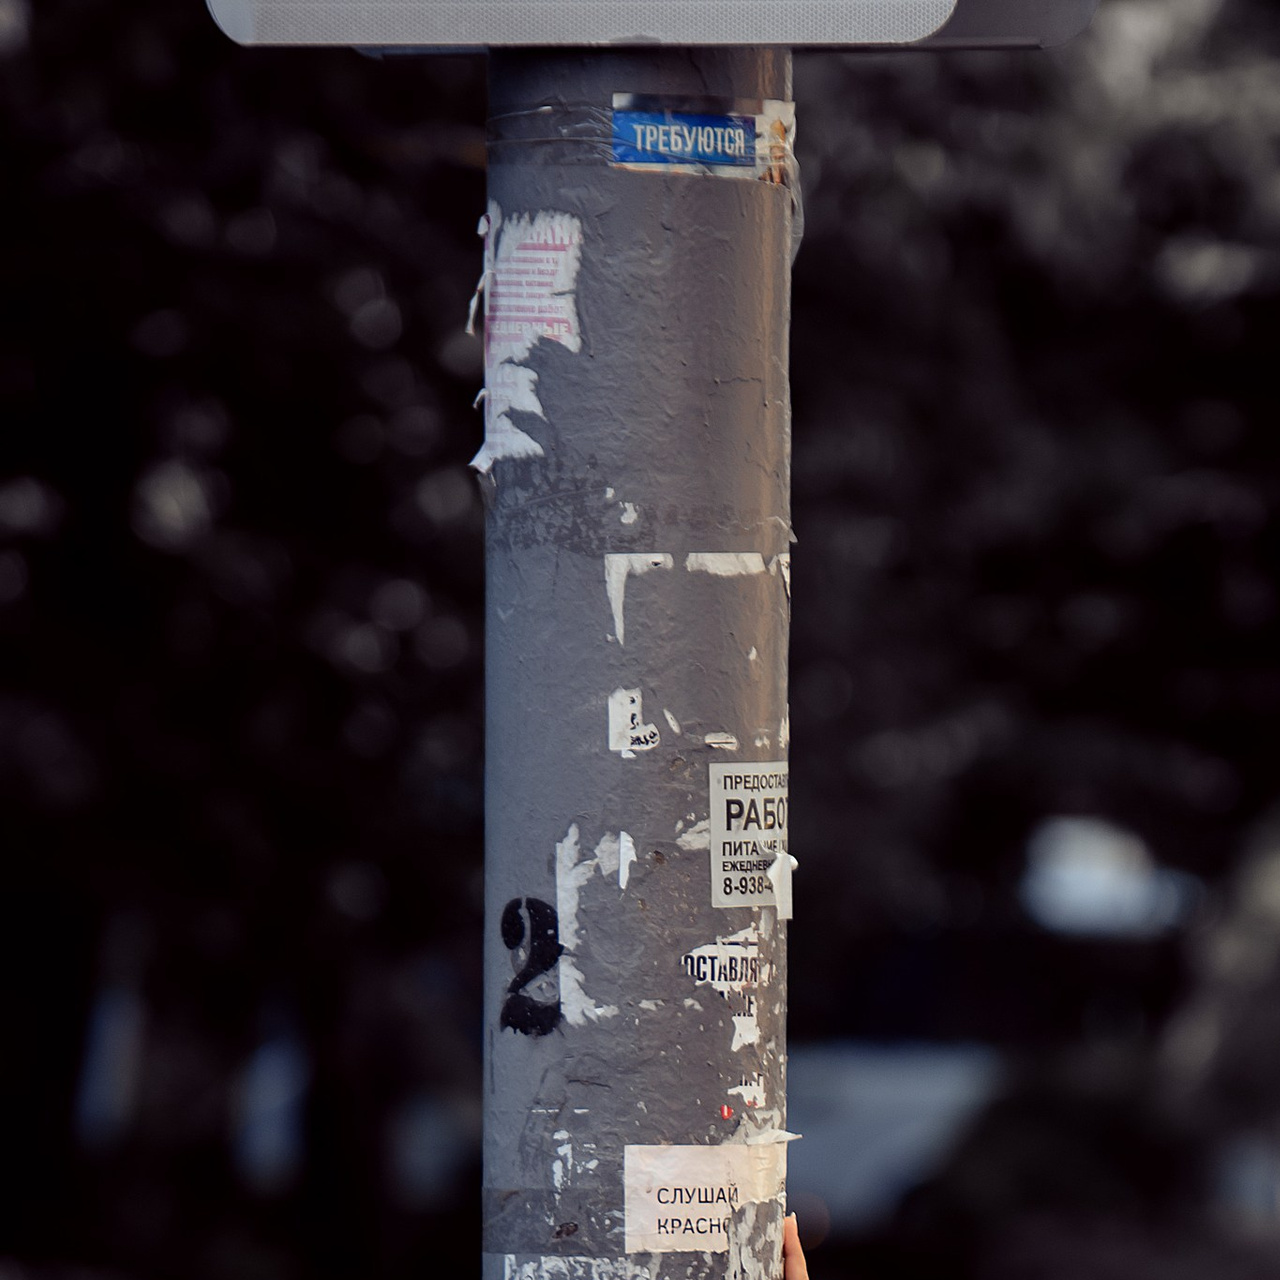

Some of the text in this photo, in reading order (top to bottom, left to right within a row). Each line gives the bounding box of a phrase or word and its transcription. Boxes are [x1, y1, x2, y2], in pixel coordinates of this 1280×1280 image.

[633, 124, 745, 156] ТРЕБУЮТСЯ
[722, 840, 777, 856] ПИТАИЕ
[501, 897, 565, 1037] 2
[657, 1183, 739, 1205] СЛУШАЙ
